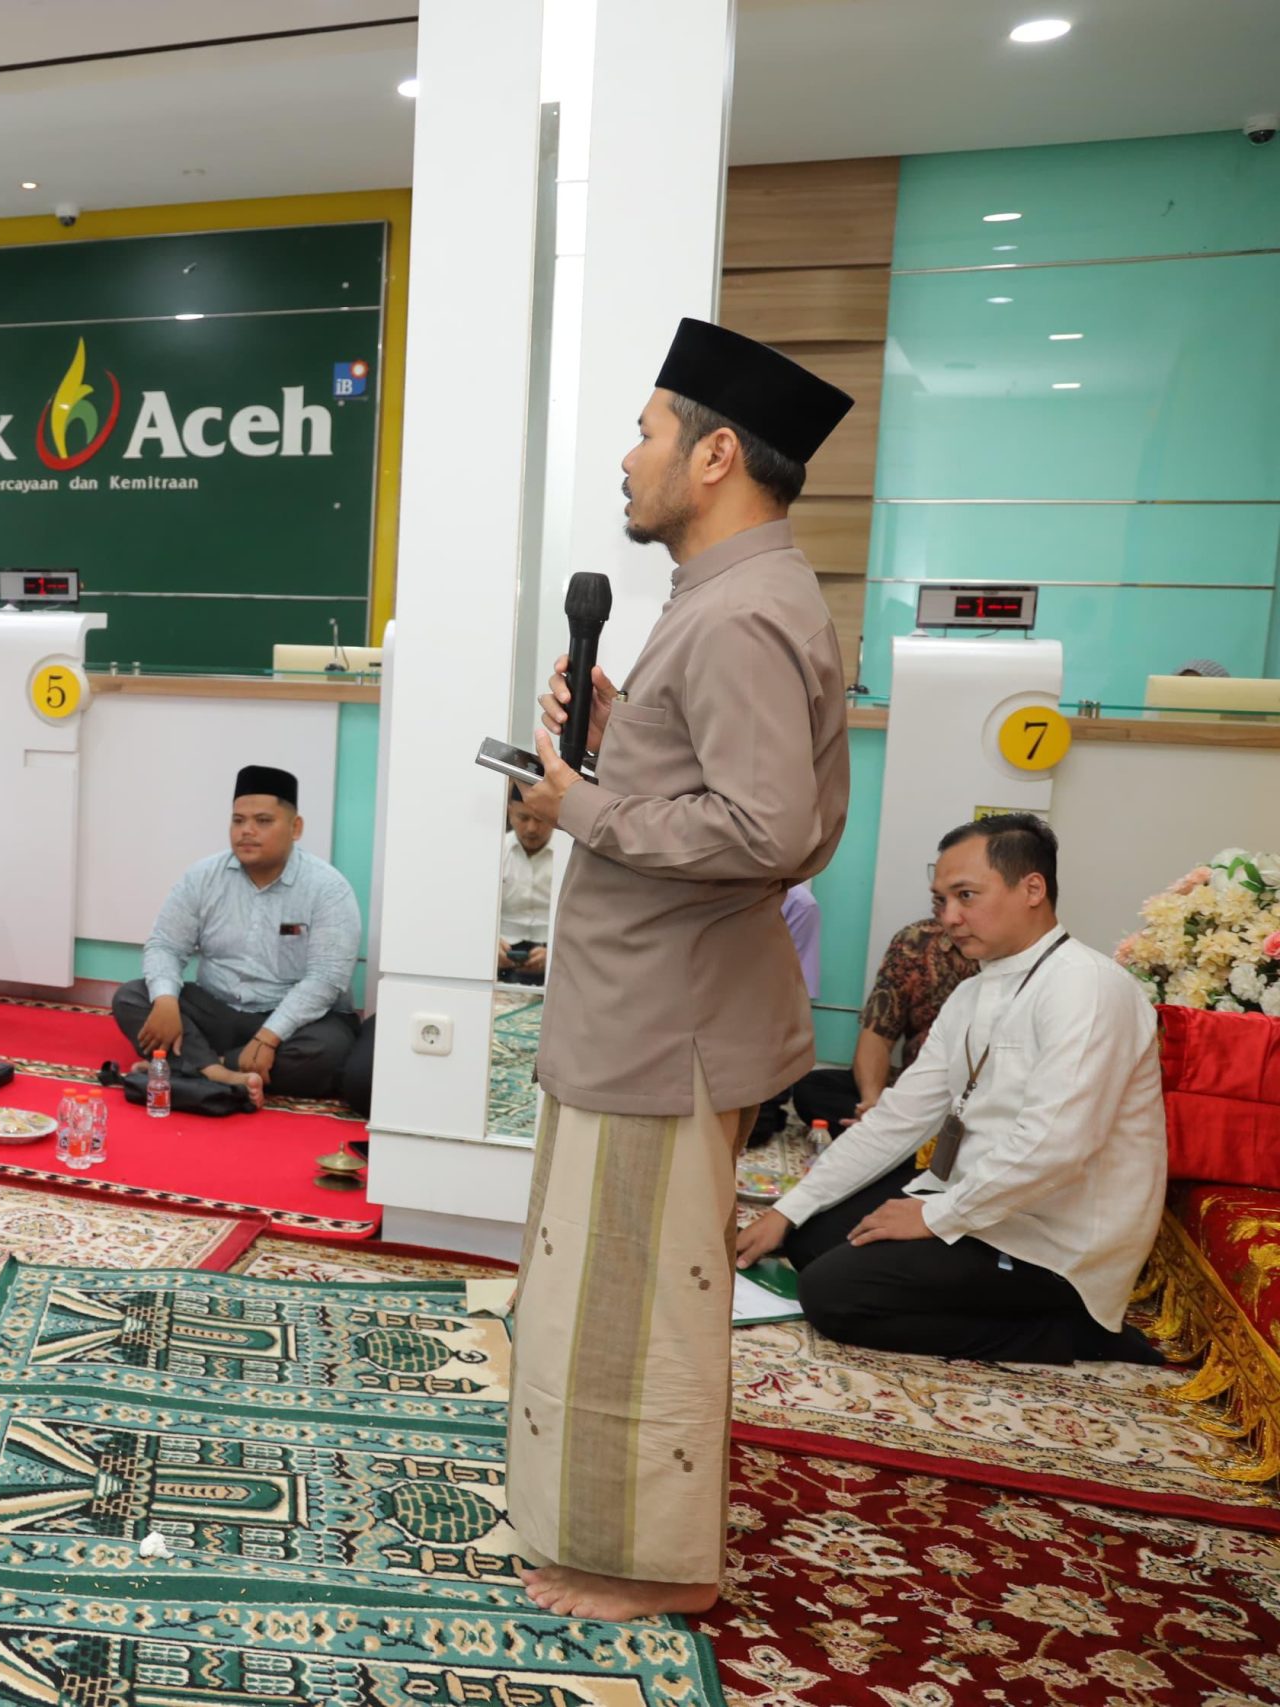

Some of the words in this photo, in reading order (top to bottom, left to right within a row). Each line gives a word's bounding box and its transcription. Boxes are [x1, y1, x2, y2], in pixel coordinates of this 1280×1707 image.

[336, 378, 353, 395] iB
[122, 385, 333, 458] Aceh
[69, 476, 98, 490] dan
[109, 475, 199, 490] Kemitraan
[46, 675, 66, 708] 5
[1024, 721, 1049, 760] 7
